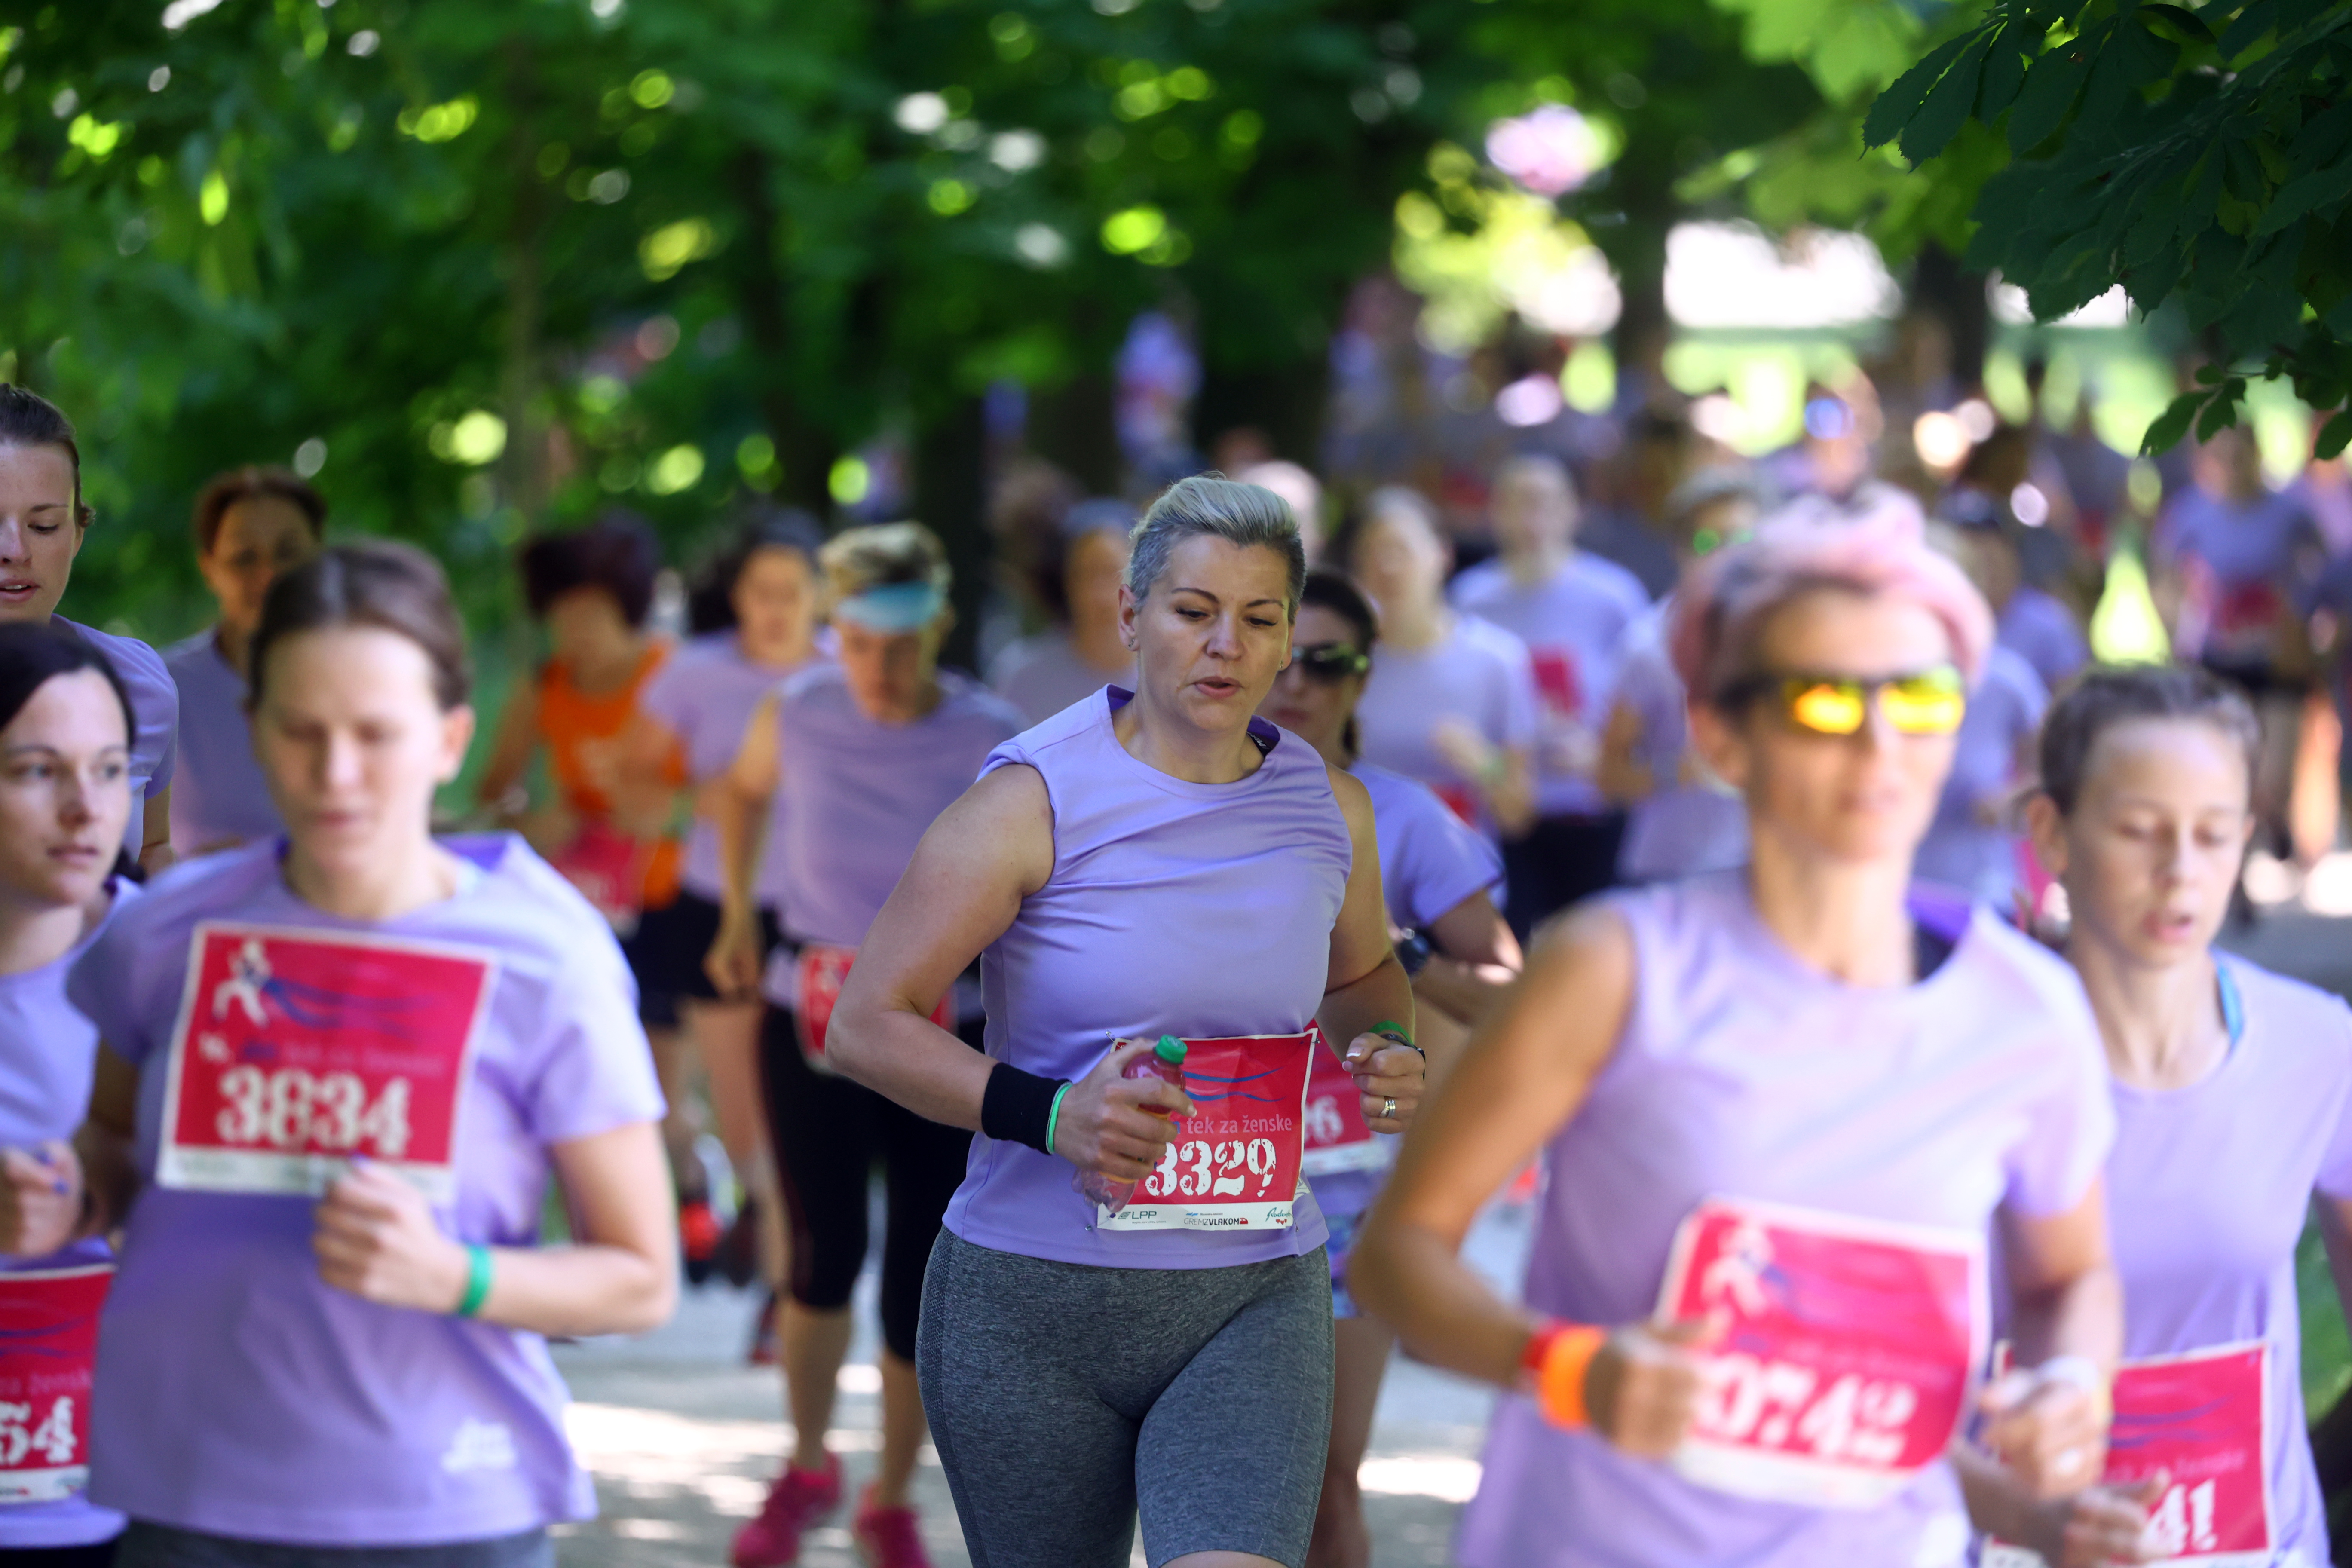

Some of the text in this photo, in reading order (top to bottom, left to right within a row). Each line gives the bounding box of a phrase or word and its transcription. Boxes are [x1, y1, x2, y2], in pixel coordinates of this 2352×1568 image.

[215, 1065, 412, 1156] 3834
[1187, 1116, 1214, 1134] tek
[1219, 1120, 1238, 1133] za
[1242, 1114, 1292, 1133] ženske
[1145, 1138, 1276, 1197] 3329
[1132, 1211, 1157, 1219] LPP
[0, 1396, 77, 1464] 54
[2138, 1478, 2218, 1555] 41
